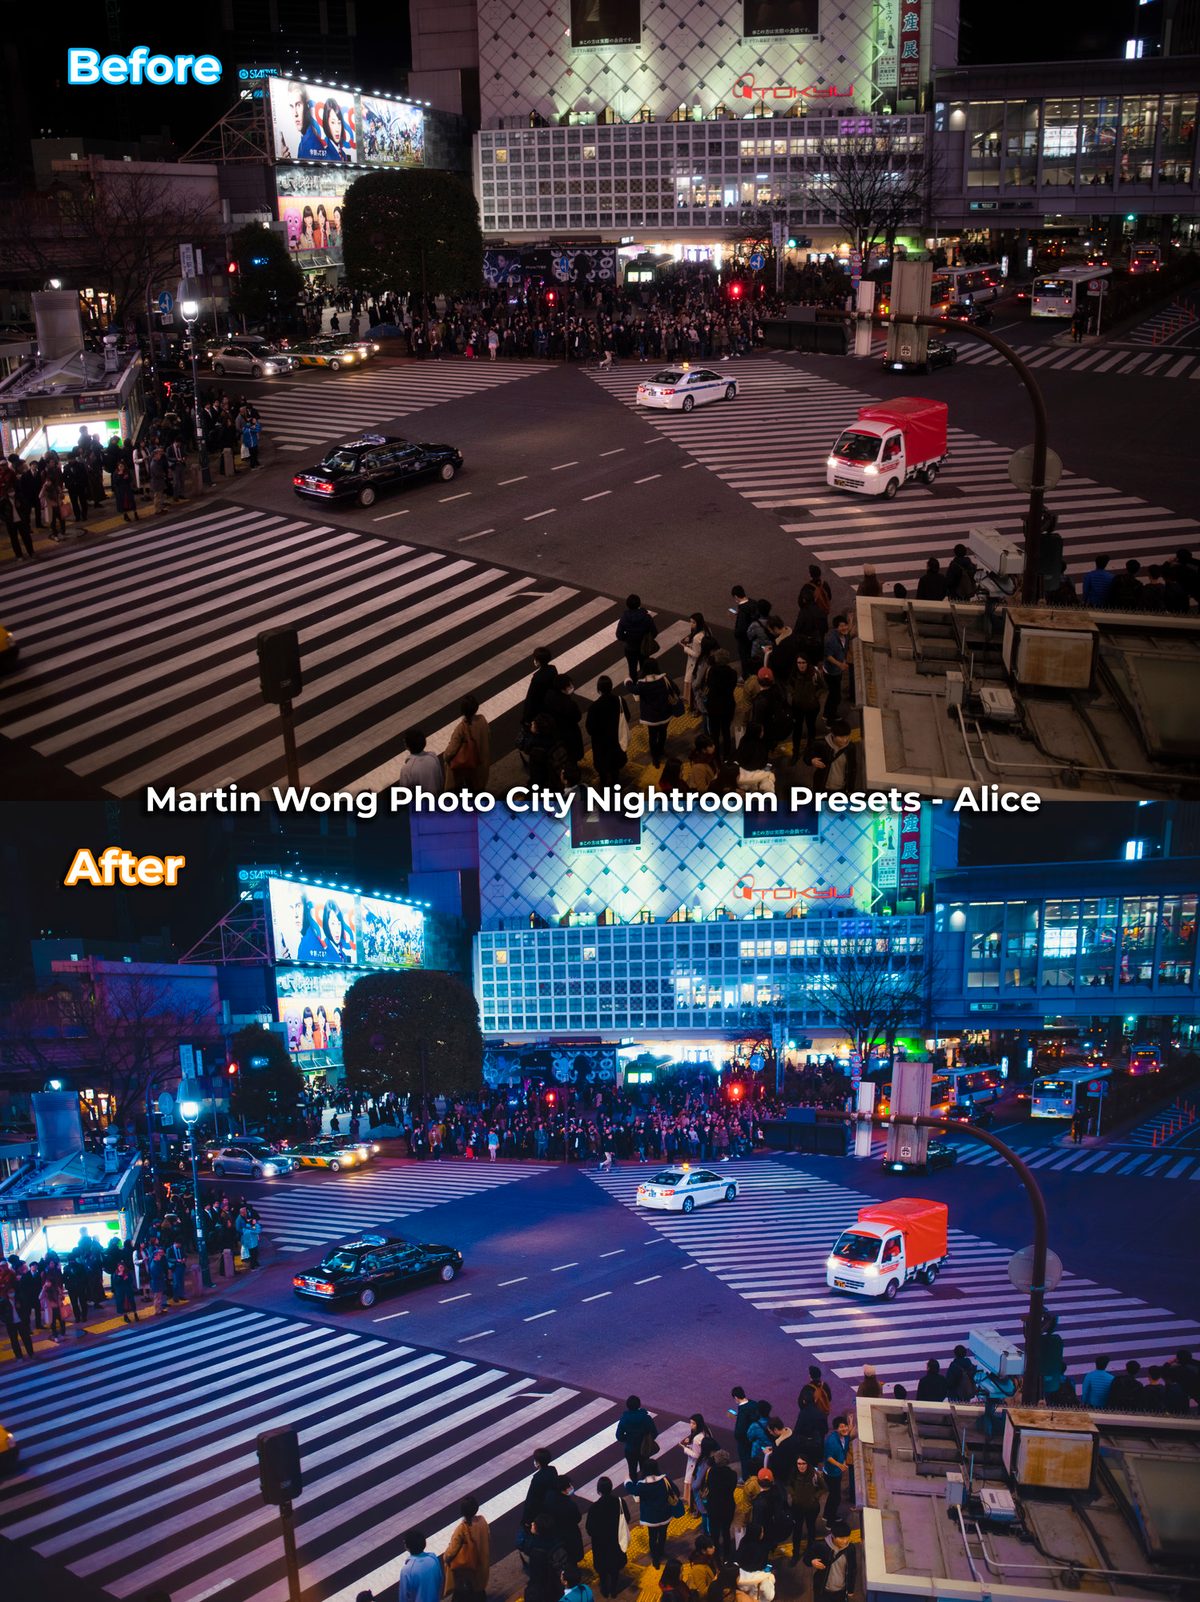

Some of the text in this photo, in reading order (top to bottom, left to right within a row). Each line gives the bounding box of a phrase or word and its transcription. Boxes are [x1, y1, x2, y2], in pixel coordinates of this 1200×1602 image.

[901, 0, 919, 58] 産展
[753, 84, 854, 99] TOKYU
[753, 885, 854, 900] TOKYU
